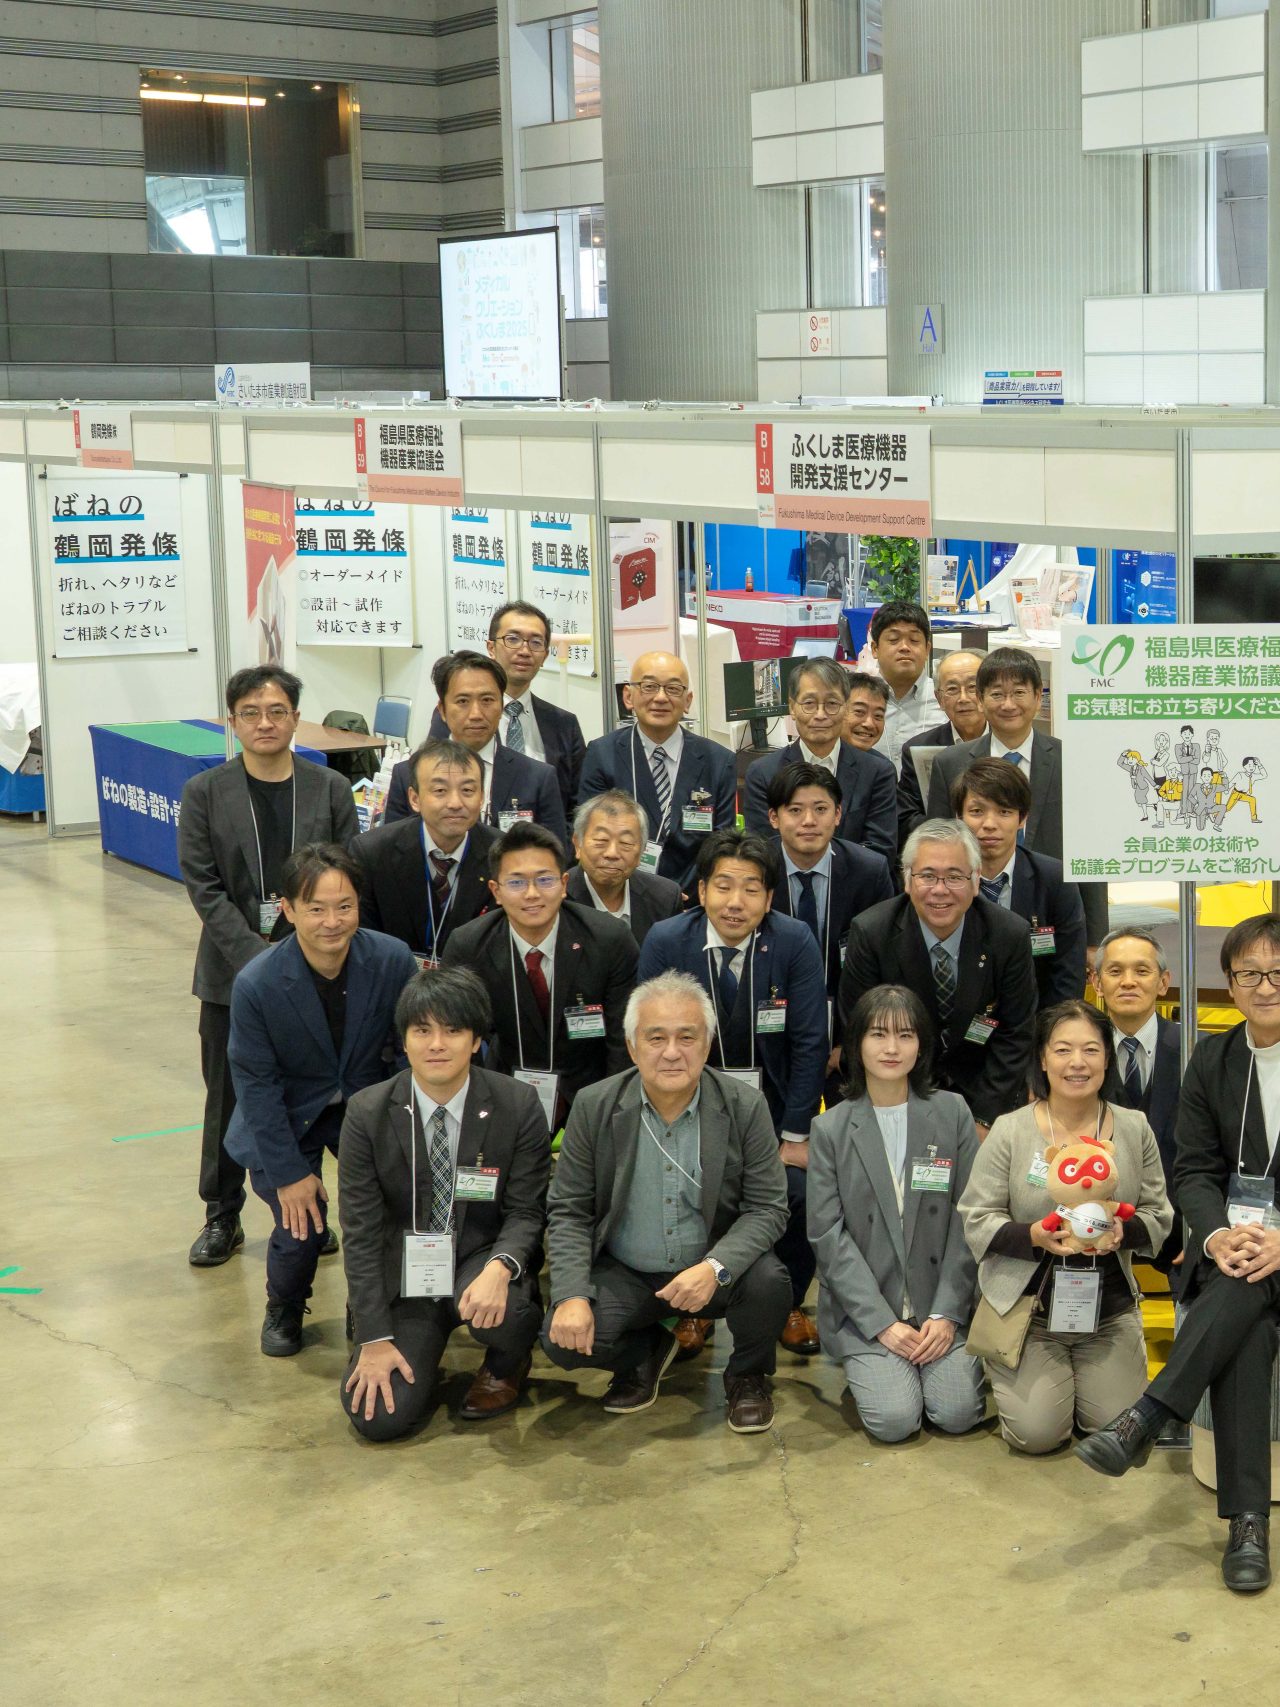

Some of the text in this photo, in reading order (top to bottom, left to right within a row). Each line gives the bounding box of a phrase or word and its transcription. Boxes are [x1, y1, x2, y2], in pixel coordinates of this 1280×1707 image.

[920, 307, 938, 342] A
[922, 343, 935, 353] Hall
[380, 424, 444, 447] 福島県医療福祉
[791, 433, 907, 462] ふくしま医療機器
[380, 448, 445, 472] 機器産業協議会
[789, 463, 908, 492] 開発支援センター
[54, 492, 143, 517] ばねの
[778, 507, 805, 519] Fukushima
[805, 509, 826, 521] Medical
[826, 510, 845, 522] Device
[845, 511, 881, 523] Development
[882, 513, 906, 526] Support
[906, 515, 926, 526] Centre
[54, 532, 178, 559] 鶴岡発條
[296, 528, 405, 552] 鶴岡発條
[453, 534, 504, 562] 鶴岡発條
[532, 541, 590, 570] 鶴岡発條
[58, 574, 178, 592] 折れ、ヘタリなど
[61, 599, 167, 616] ばねのトラブル
[456, 601, 500, 618] ばねのトラブ
[705, 603, 724, 613] NEKO
[63, 625, 167, 641] ご相談ください
[316, 619, 402, 634] 対応できます
[1090, 678, 1116, 688] FMC
[1123, 836, 1260, 853] 会員企業の技術や
